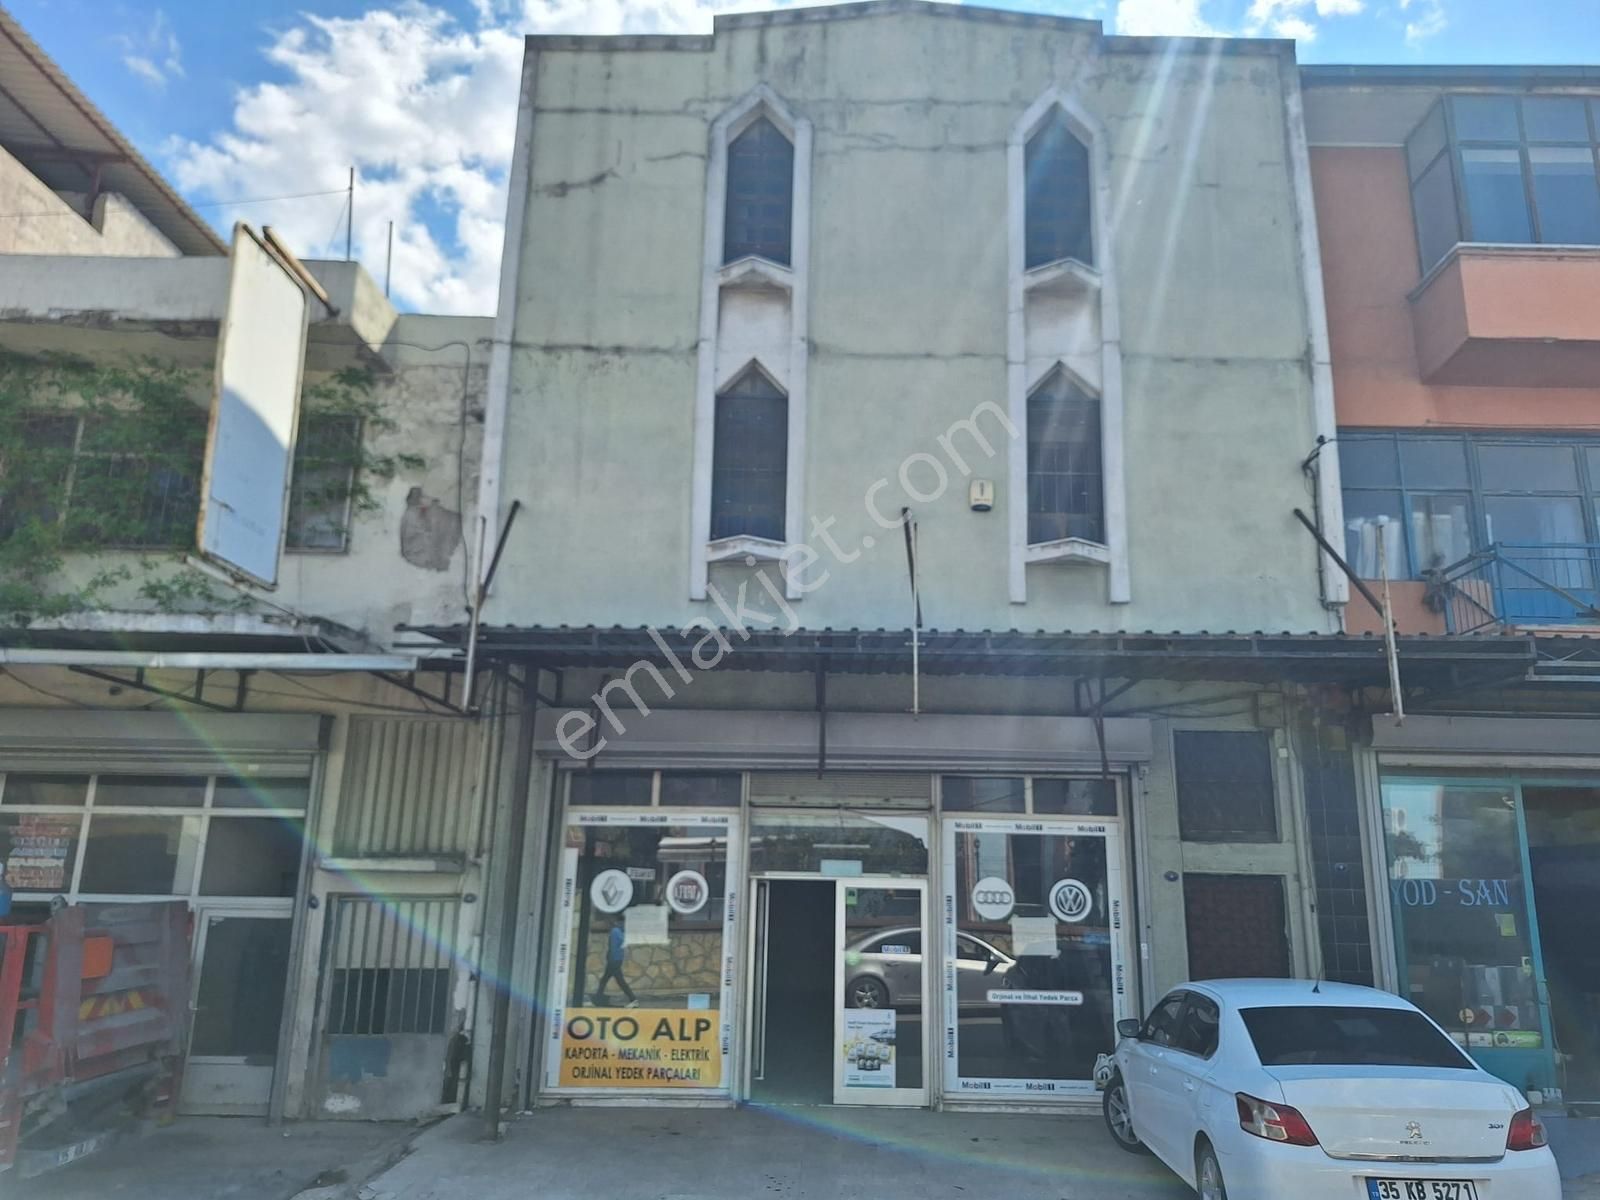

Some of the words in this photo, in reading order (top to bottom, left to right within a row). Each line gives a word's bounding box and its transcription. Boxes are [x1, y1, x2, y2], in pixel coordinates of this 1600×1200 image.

[1459, 879, 1509, 906] SAN
[567, 1016, 639, 1040] OTO
[651, 1017, 711, 1041] ALP
[565, 1049, 609, 1060] KAPORTA
[617, 1046, 661, 1060] MEKANİK
[671, 1047, 710, 1061] ELEKTRİK
[572, 1064, 612, 1079] ORJİNAL
[616, 1066, 644, 1079] YEDEK
[647, 1067, 701, 1082] PARÇALARI
[1379, 1181, 1400, 1199] 35
[1405, 1181, 1427, 1200] KB
[1432, 1182, 1473, 1200] 5271
